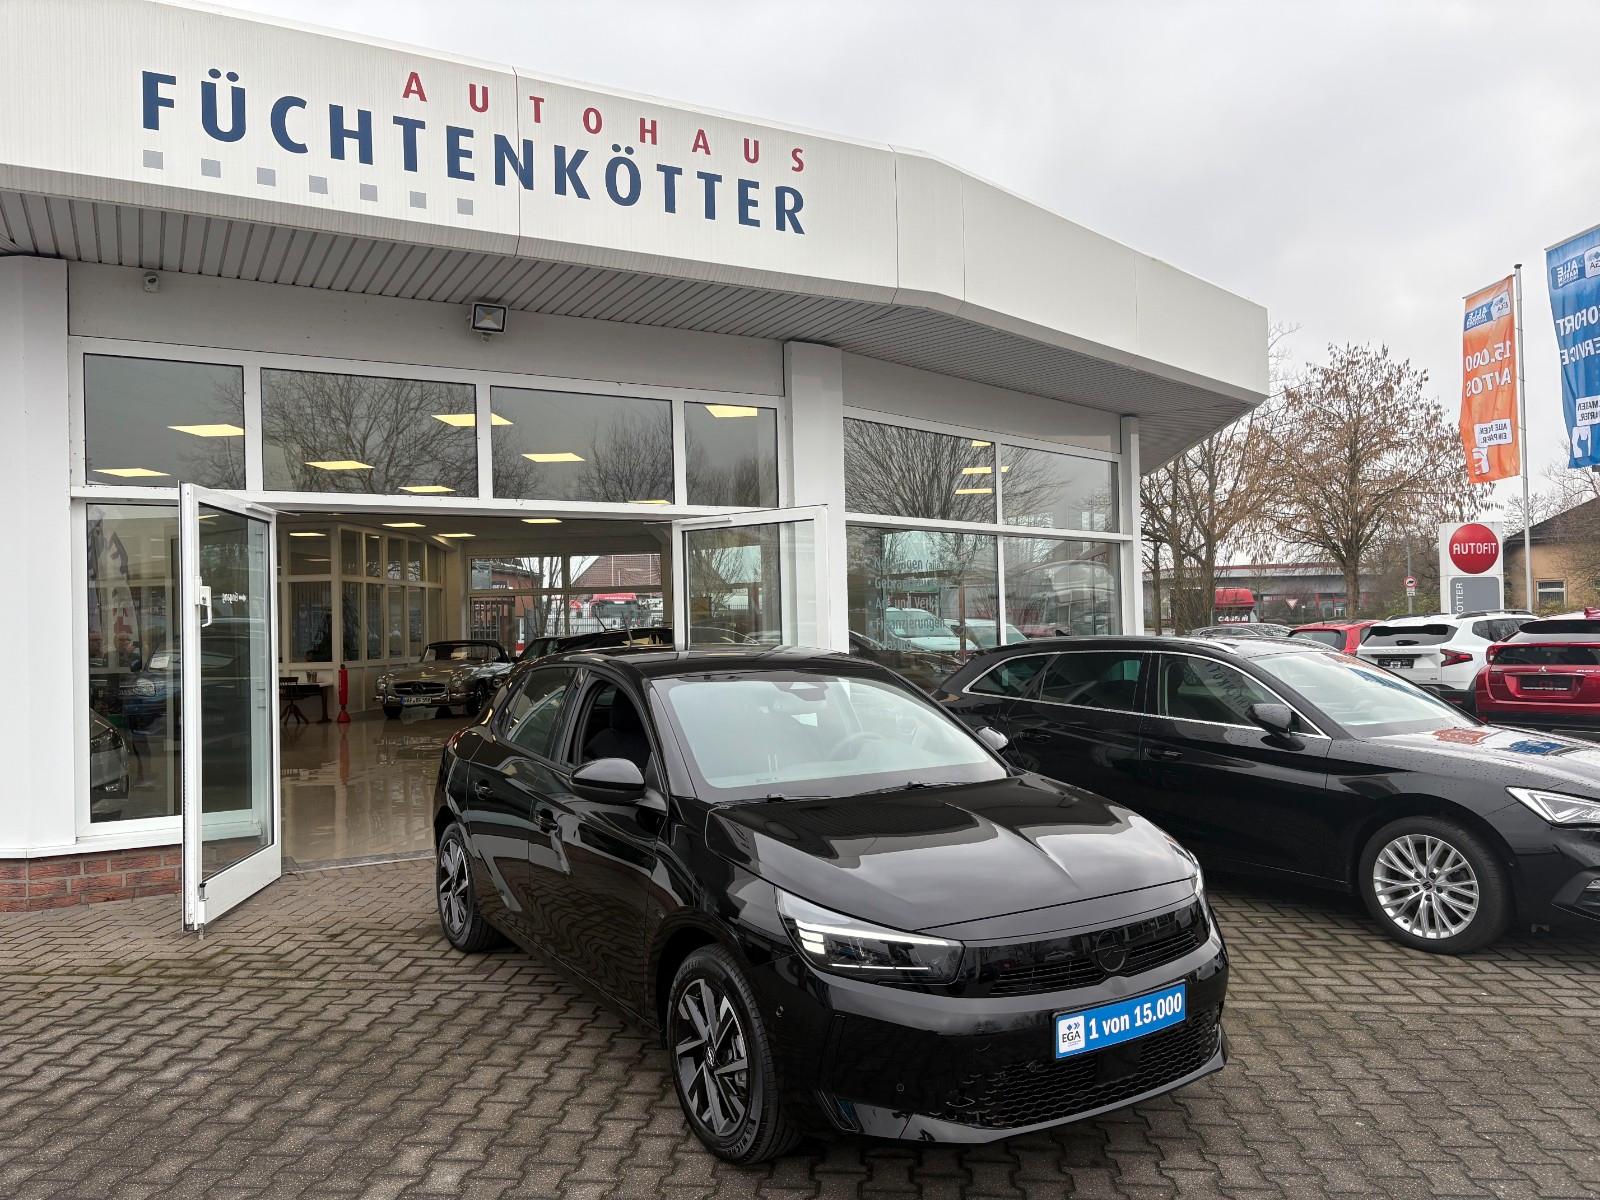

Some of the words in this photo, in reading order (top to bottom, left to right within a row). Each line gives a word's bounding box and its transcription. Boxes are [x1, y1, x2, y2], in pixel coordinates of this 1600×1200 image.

[402, 71, 805, 172] AUTOHAUS
[142, 68, 806, 235] FÜCHTENKÖTTER
[1452, 542, 1497, 555] AUTOFIT
[876, 617, 945, 632] Fianzierungen
[1089, 1017, 1099, 1040] 1
[1102, 1014, 1130, 1036] von
[1134, 992, 1182, 1027] 15.000
[1061, 1030, 1081, 1044] EGA
